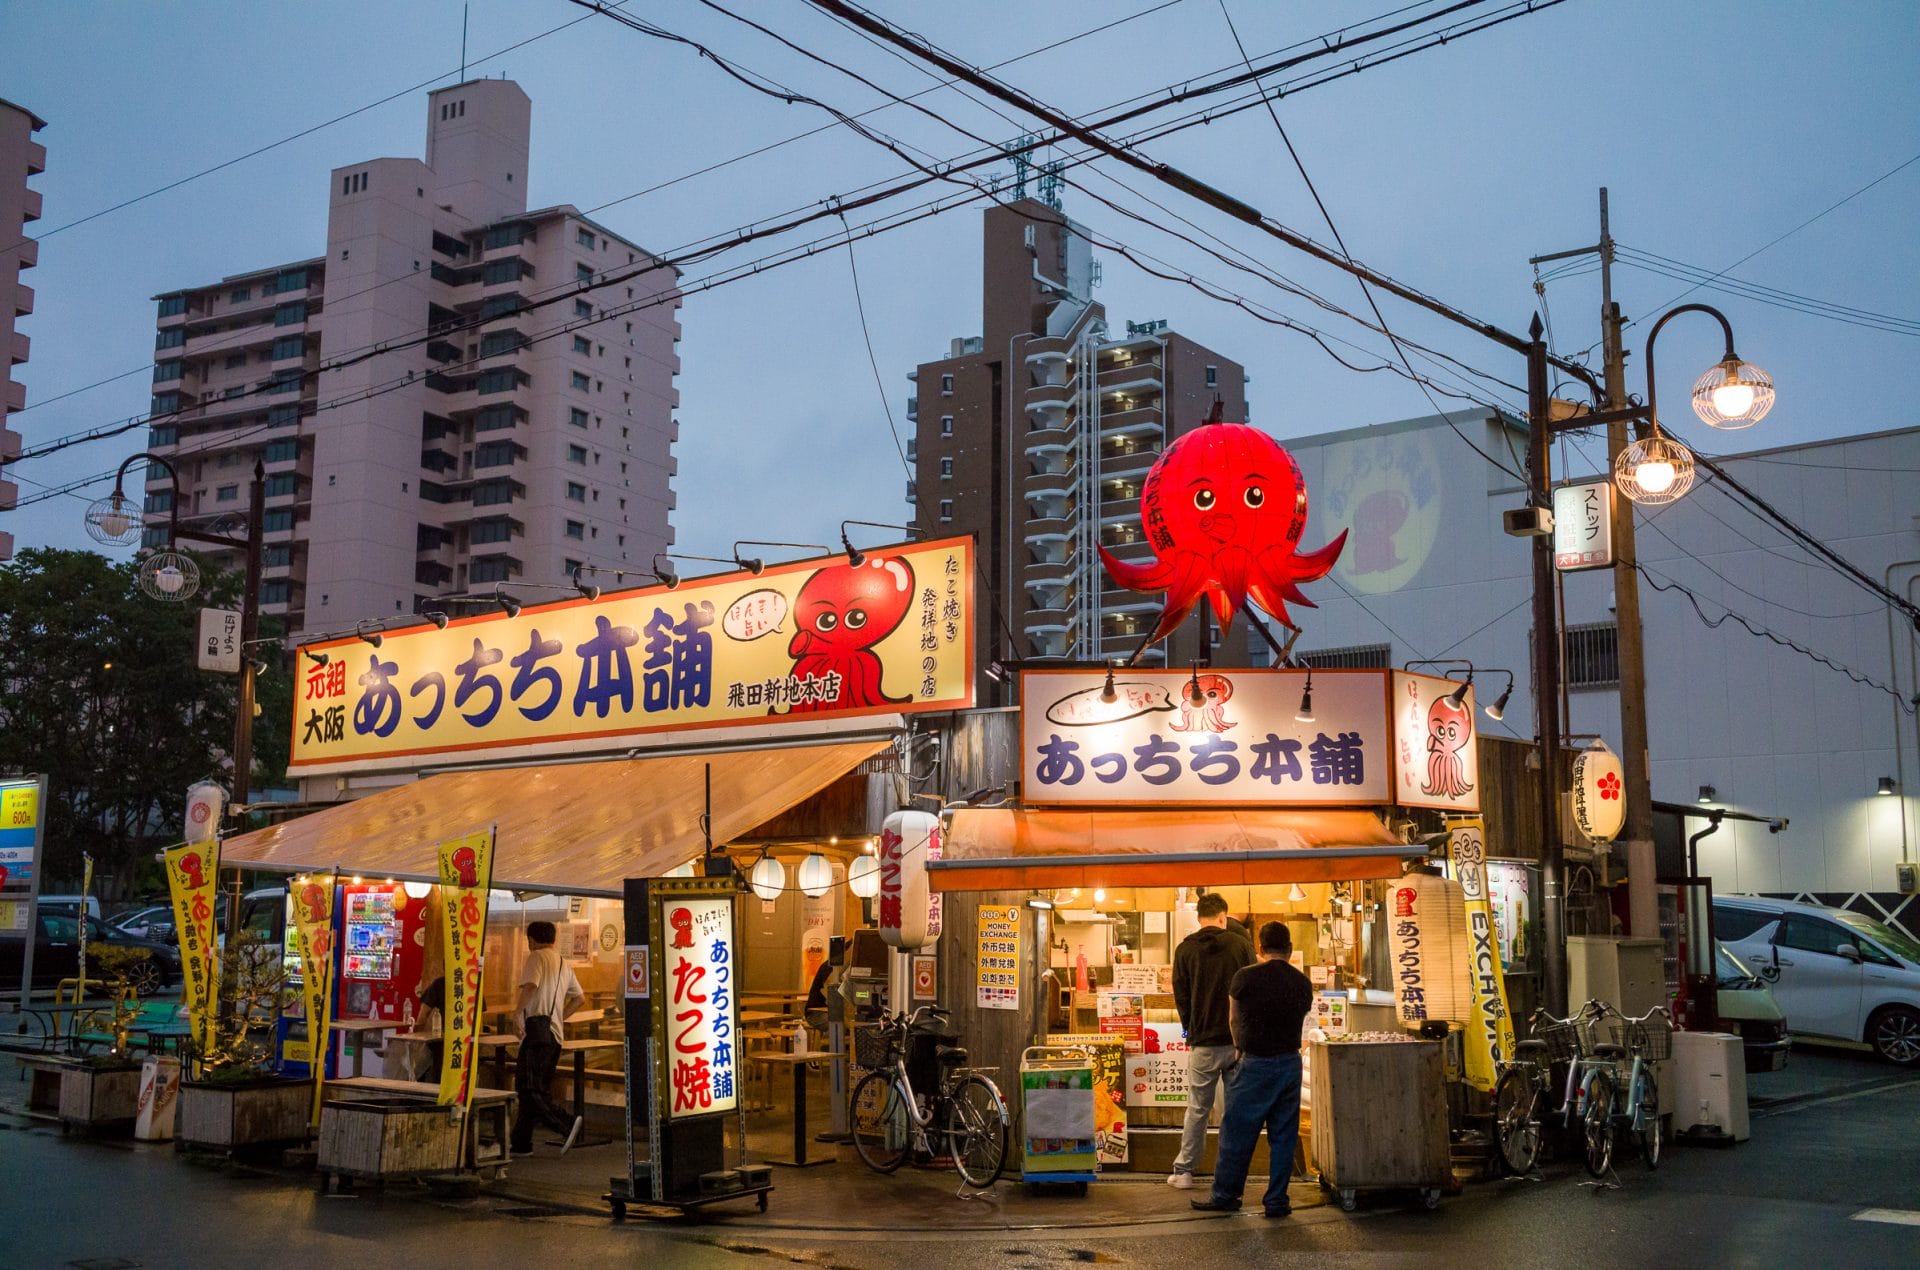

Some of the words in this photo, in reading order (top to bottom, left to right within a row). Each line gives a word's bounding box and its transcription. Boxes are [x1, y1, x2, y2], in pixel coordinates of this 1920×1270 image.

[1585, 488, 1600, 541] ストップ
[943, 554, 959, 641] たこ焼き
[224, 614, 236, 655] 広げよう
[920, 587, 938, 697] 発祥地の店
[305, 659, 346, 701] 元祖
[353, 600, 715, 738] あっちち本舗
[726, 671, 842, 709] 飛田新地本店
[302, 704, 346, 746] 大阪
[1036, 731, 1365, 786] あっちち本舗
[980, 930, 1018, 939] EXCHANGE
[987, 923, 1012, 931] MONEY
[630, 952, 644, 961] AED
[1396, 919, 1428, 1021] あっちち本舗
[672, 955, 713, 1114] たこ焼
[709, 938, 733, 1100] あっちち本舗
